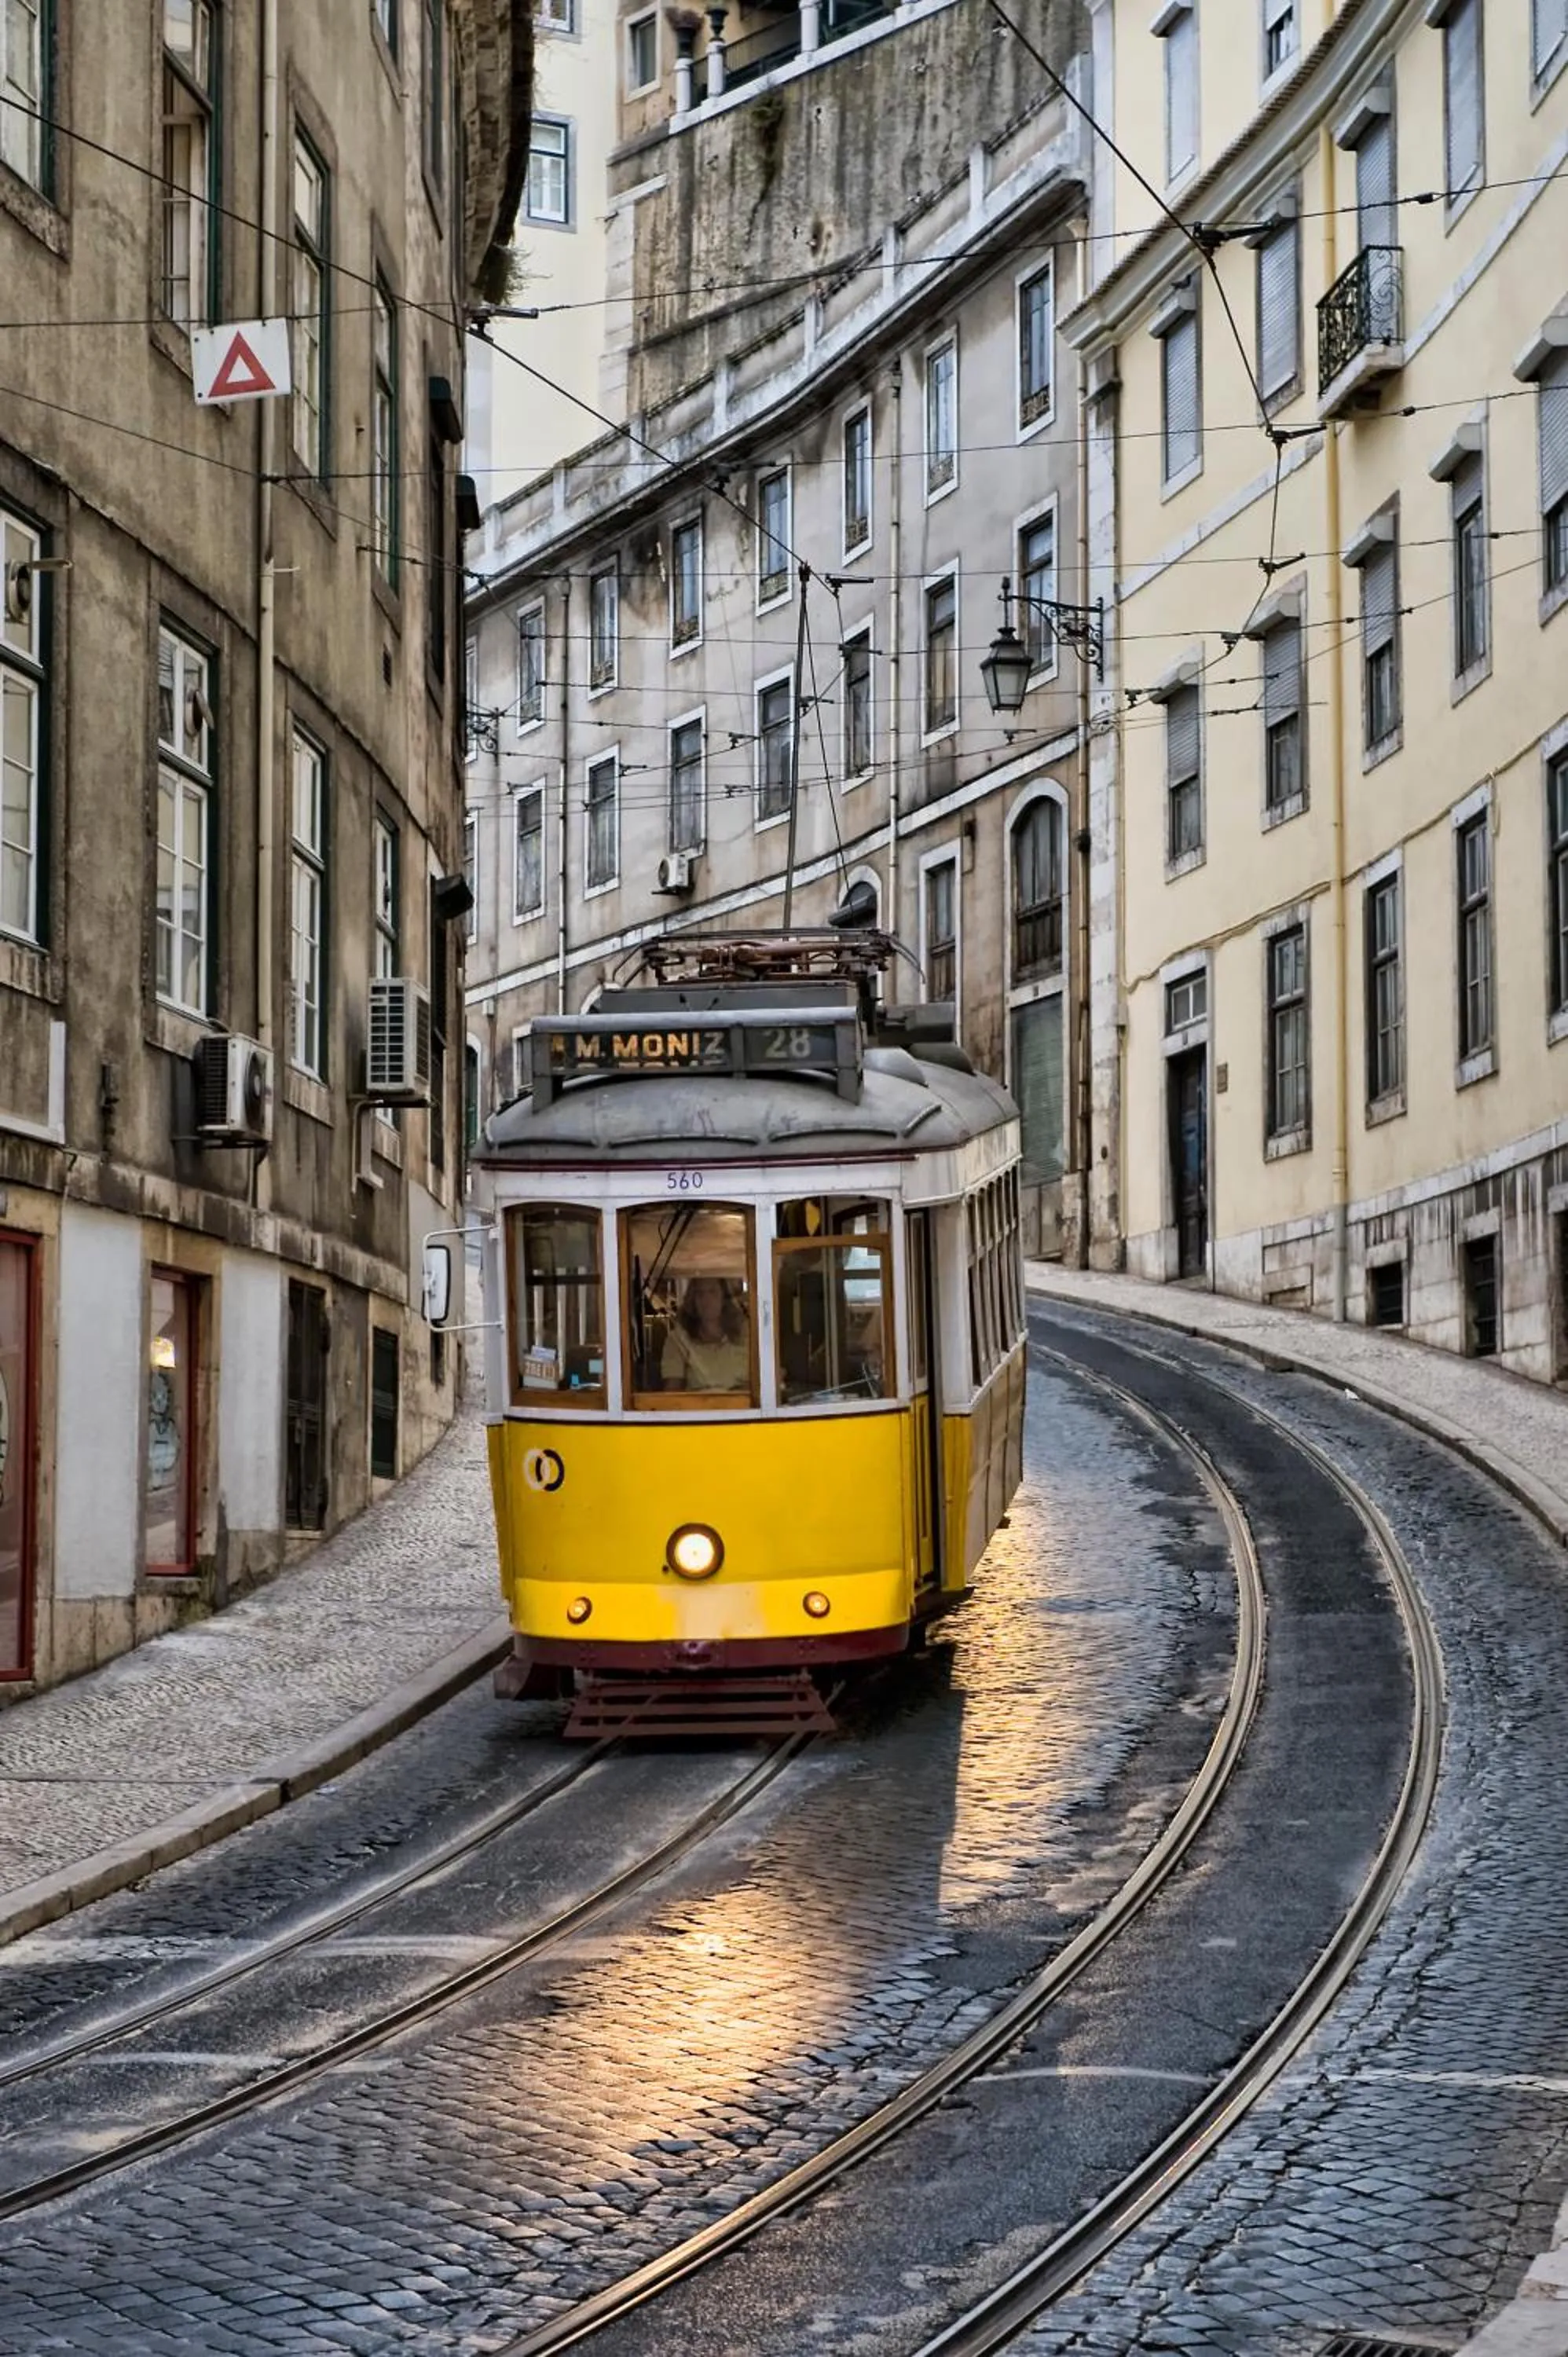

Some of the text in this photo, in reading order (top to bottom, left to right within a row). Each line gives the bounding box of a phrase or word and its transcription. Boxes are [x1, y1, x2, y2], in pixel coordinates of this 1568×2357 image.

[612, 1032, 725, 1058] MONIZ
[762, 1028, 811, 1058] 28
[667, 1171, 703, 1189] 560
